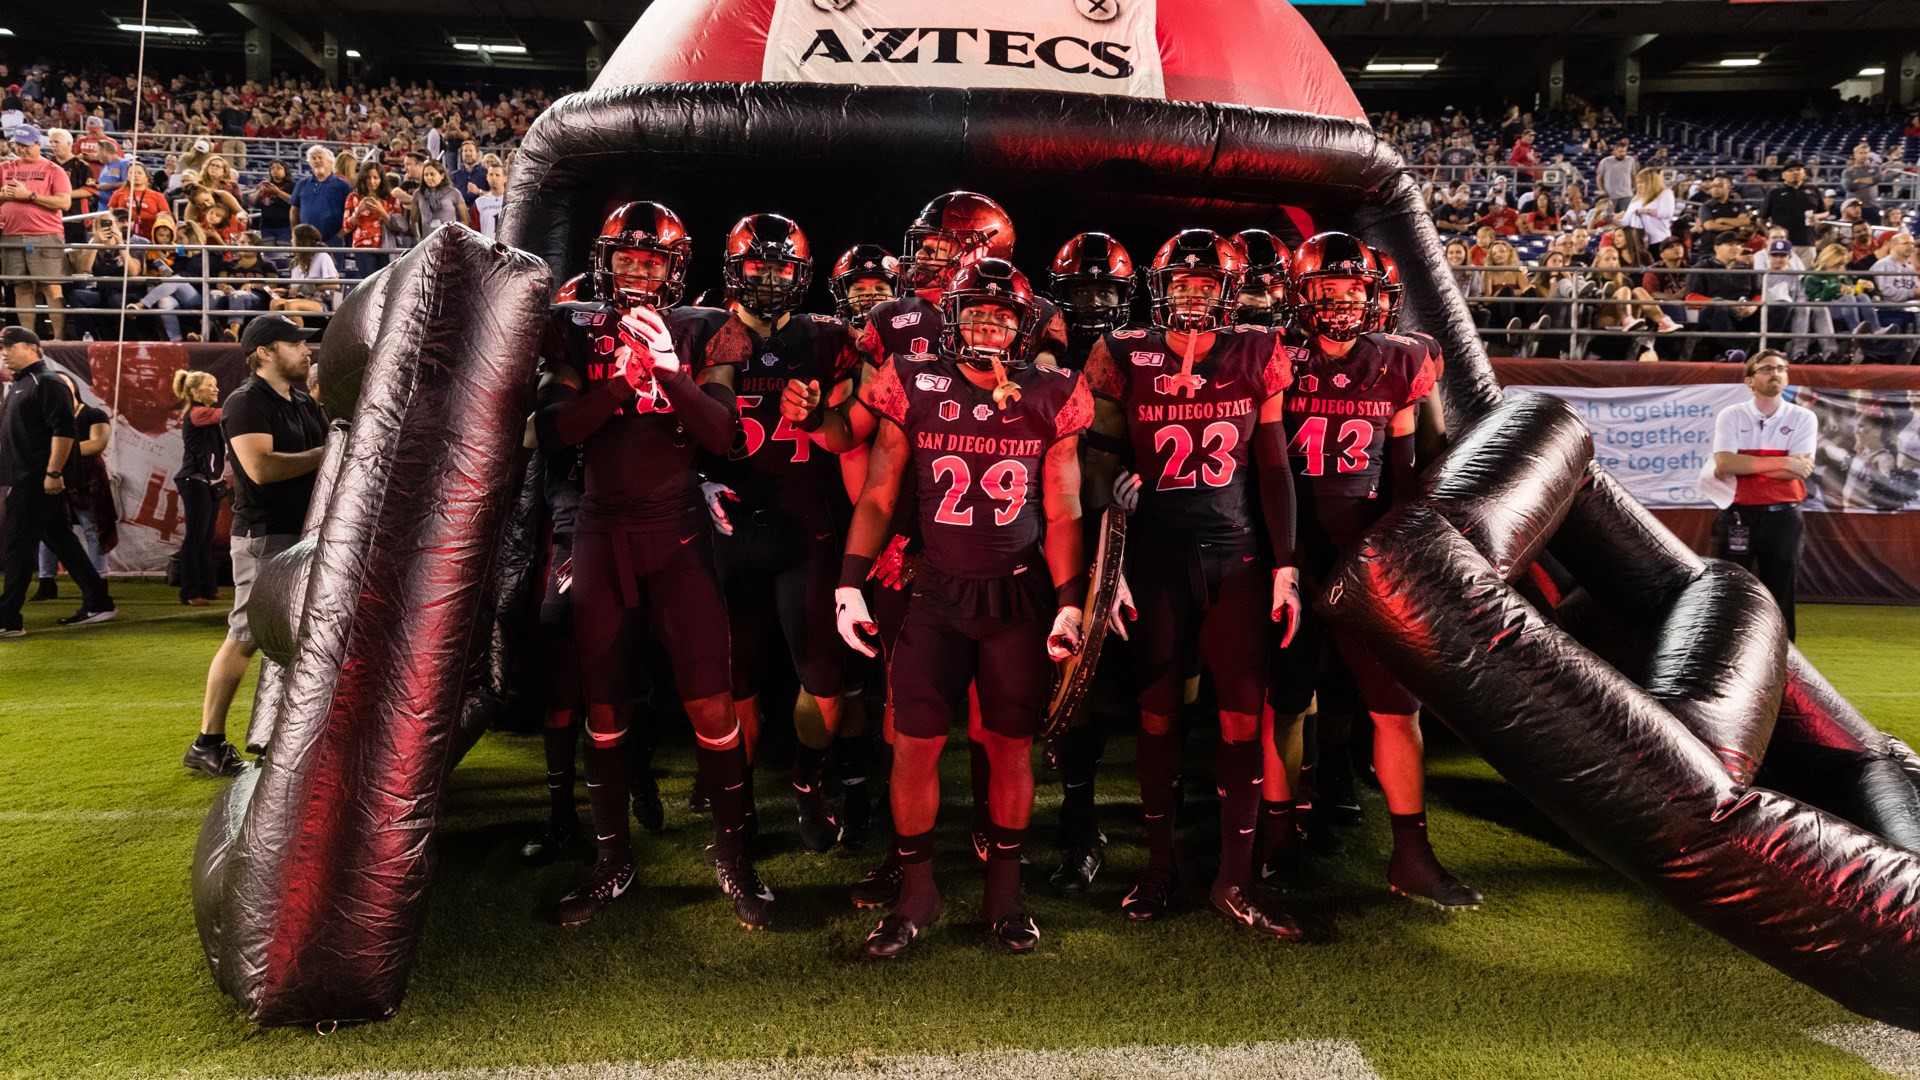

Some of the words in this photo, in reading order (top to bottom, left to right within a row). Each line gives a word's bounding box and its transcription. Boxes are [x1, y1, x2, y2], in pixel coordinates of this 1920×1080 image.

[800, 27, 1135, 80] AZTECS
[1138, 404, 1164, 421] SAN
[1167, 402, 1213, 421] DIEGO
[1216, 398, 1252, 417] STATE
[1310, 398, 1355, 415] DIEGO
[1357, 401, 1391, 416] STATE
[1609, 400, 1714, 423] together.
[728, 395, 810, 462] 54
[1606, 426, 1710, 448] together.
[918, 431, 944, 451] SAN
[946, 434, 997, 455] DIEGO
[999, 439, 1041, 456] STATE
[1154, 421, 1239, 491] 23
[1287, 416, 1374, 476] 43
[1628, 450, 1703, 474] togeth
[932, 455, 1029, 526] 29
